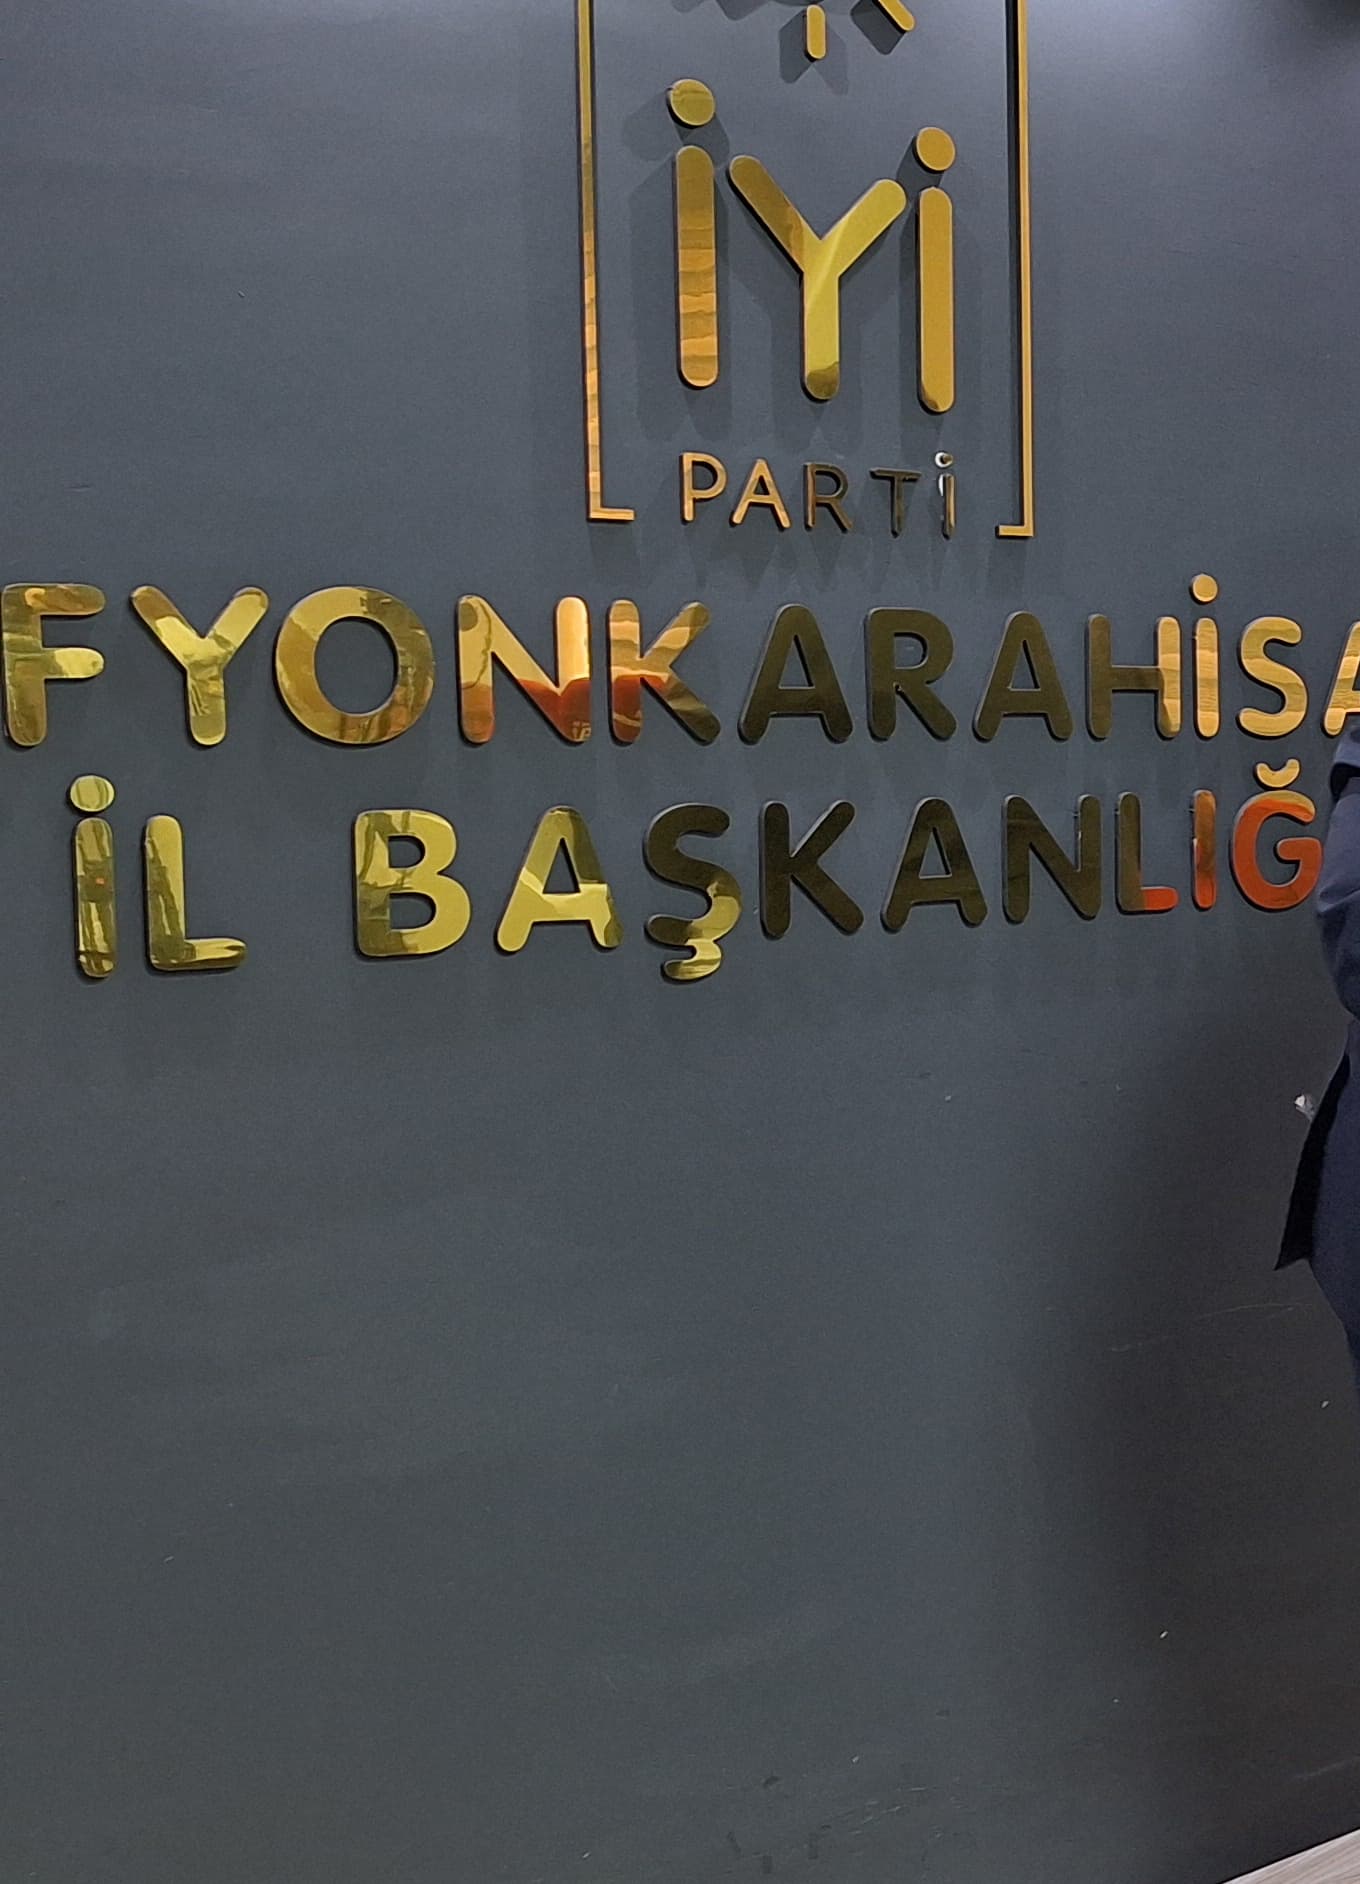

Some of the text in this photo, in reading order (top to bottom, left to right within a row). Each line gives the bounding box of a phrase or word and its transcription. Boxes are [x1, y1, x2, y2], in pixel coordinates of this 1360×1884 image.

[680, 451, 956, 538] PARTİ
[70, 758, 1323, 981] İL BAŞKANLIĞ
